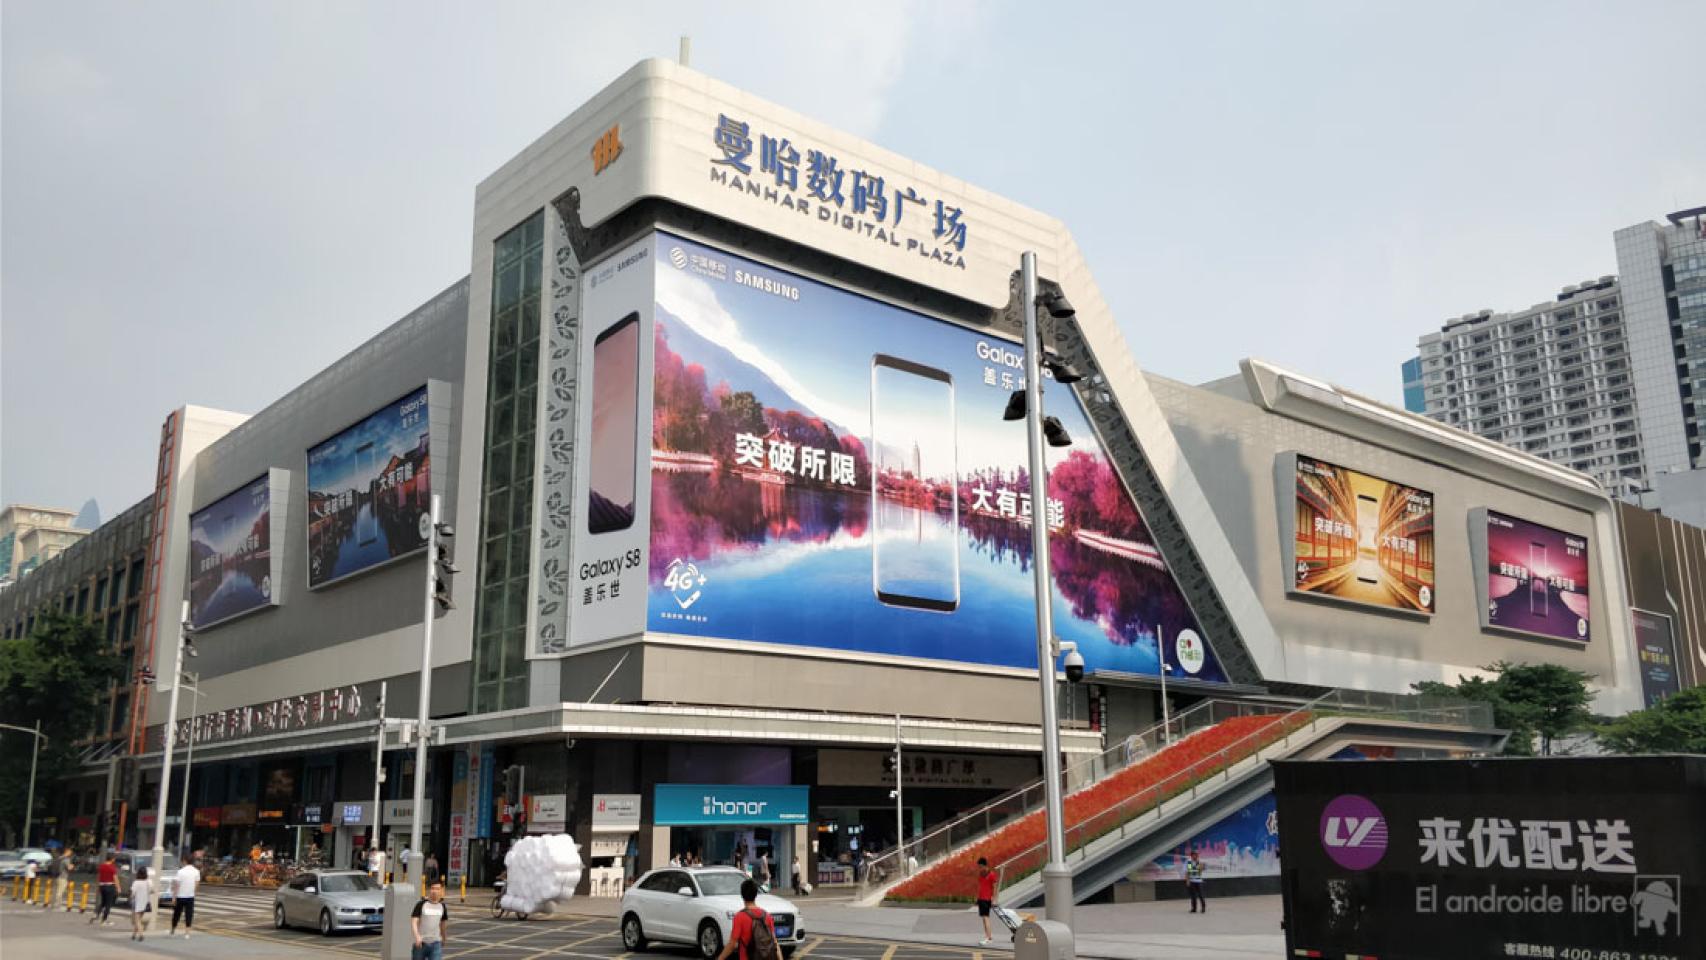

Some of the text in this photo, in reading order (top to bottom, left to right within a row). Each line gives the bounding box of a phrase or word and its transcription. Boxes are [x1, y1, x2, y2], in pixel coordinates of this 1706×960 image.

[711, 113, 968, 252] 曼哈数码广场
[711, 167, 967, 270] MANHAR DIGITAL PLAZA
[735, 270, 799, 300] SAMSUNG
[976, 341, 1025, 370] Galax
[735, 432, 856, 487] 突破所限
[580, 548, 641, 581] Galaxy S8
[711, 796, 768, 815] honor
[1325, 816, 1380, 848] LY
[1418, 817, 1637, 874] 来优配送
